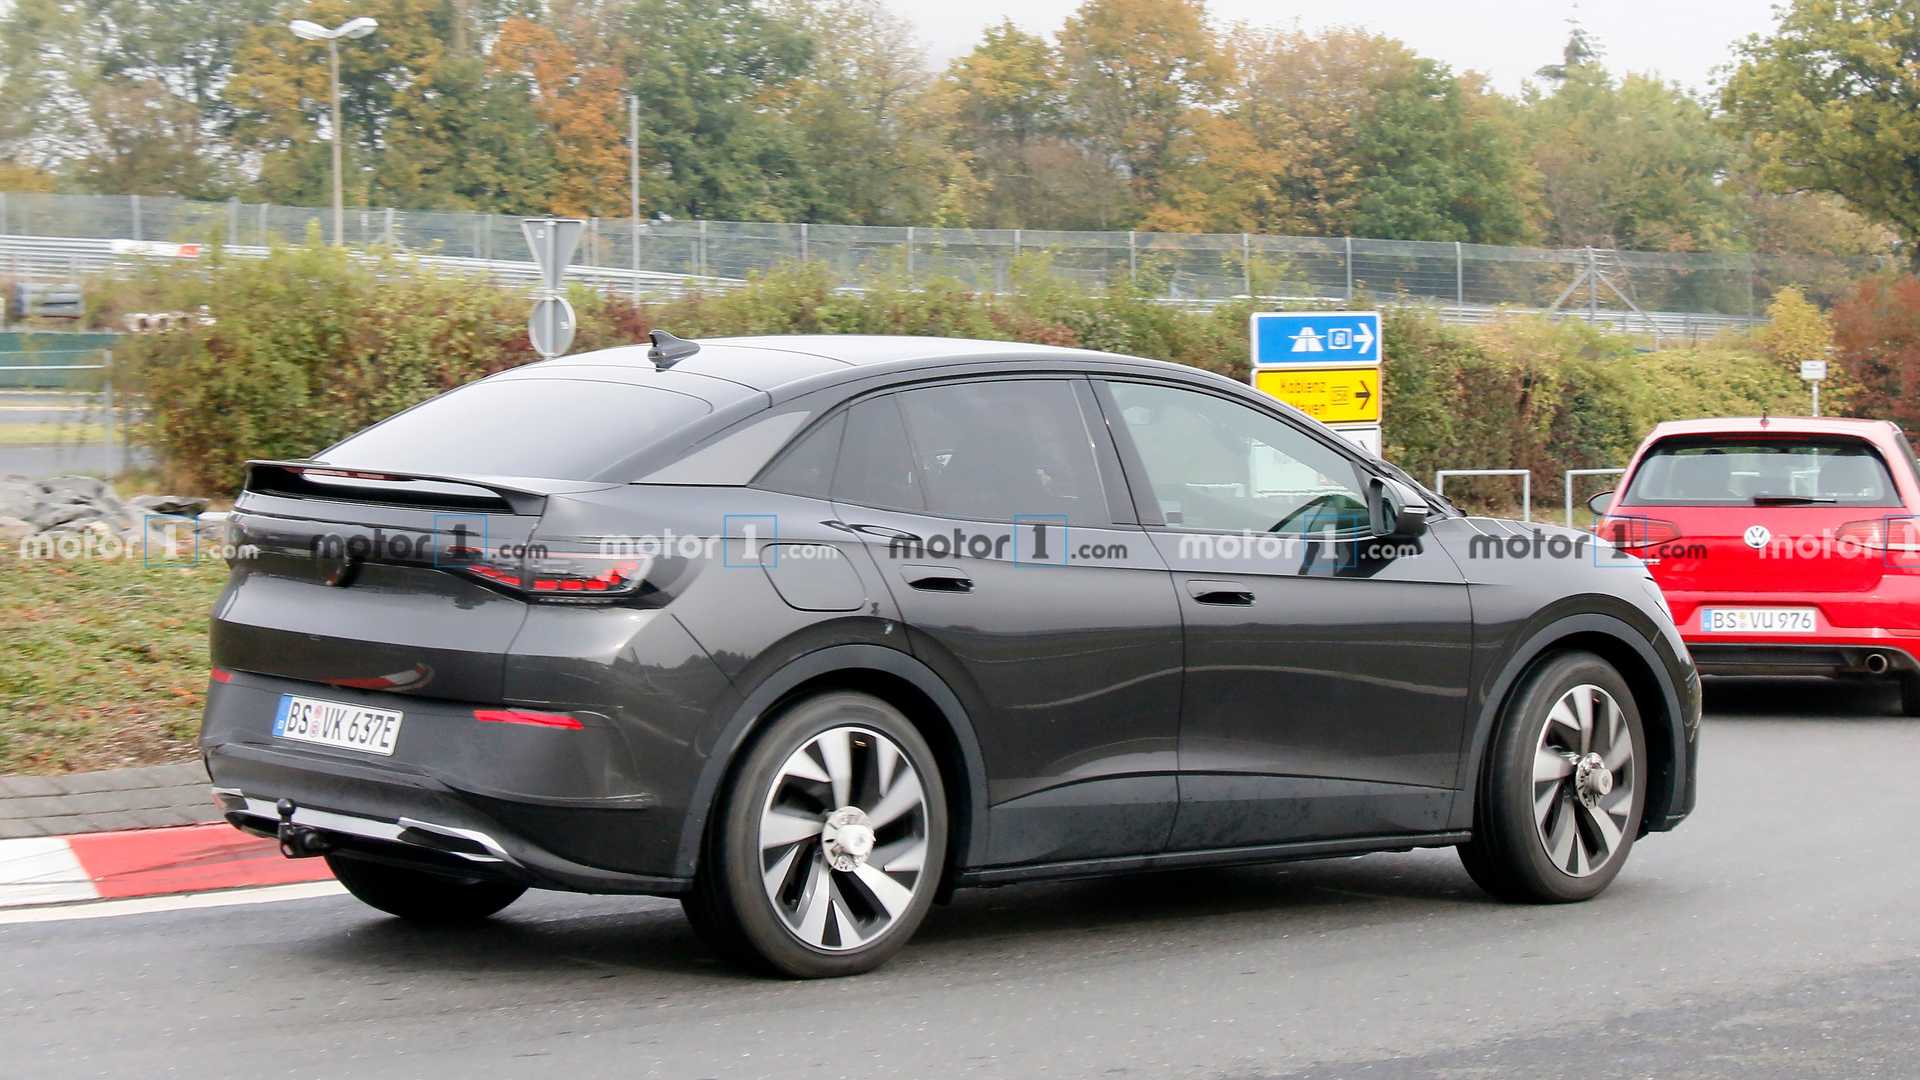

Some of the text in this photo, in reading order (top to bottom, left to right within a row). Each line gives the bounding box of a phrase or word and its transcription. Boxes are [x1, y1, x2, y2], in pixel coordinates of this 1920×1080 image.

[1713, 612, 1812, 629] BS VU 976
[286, 701, 396, 748] BS VK 637E
